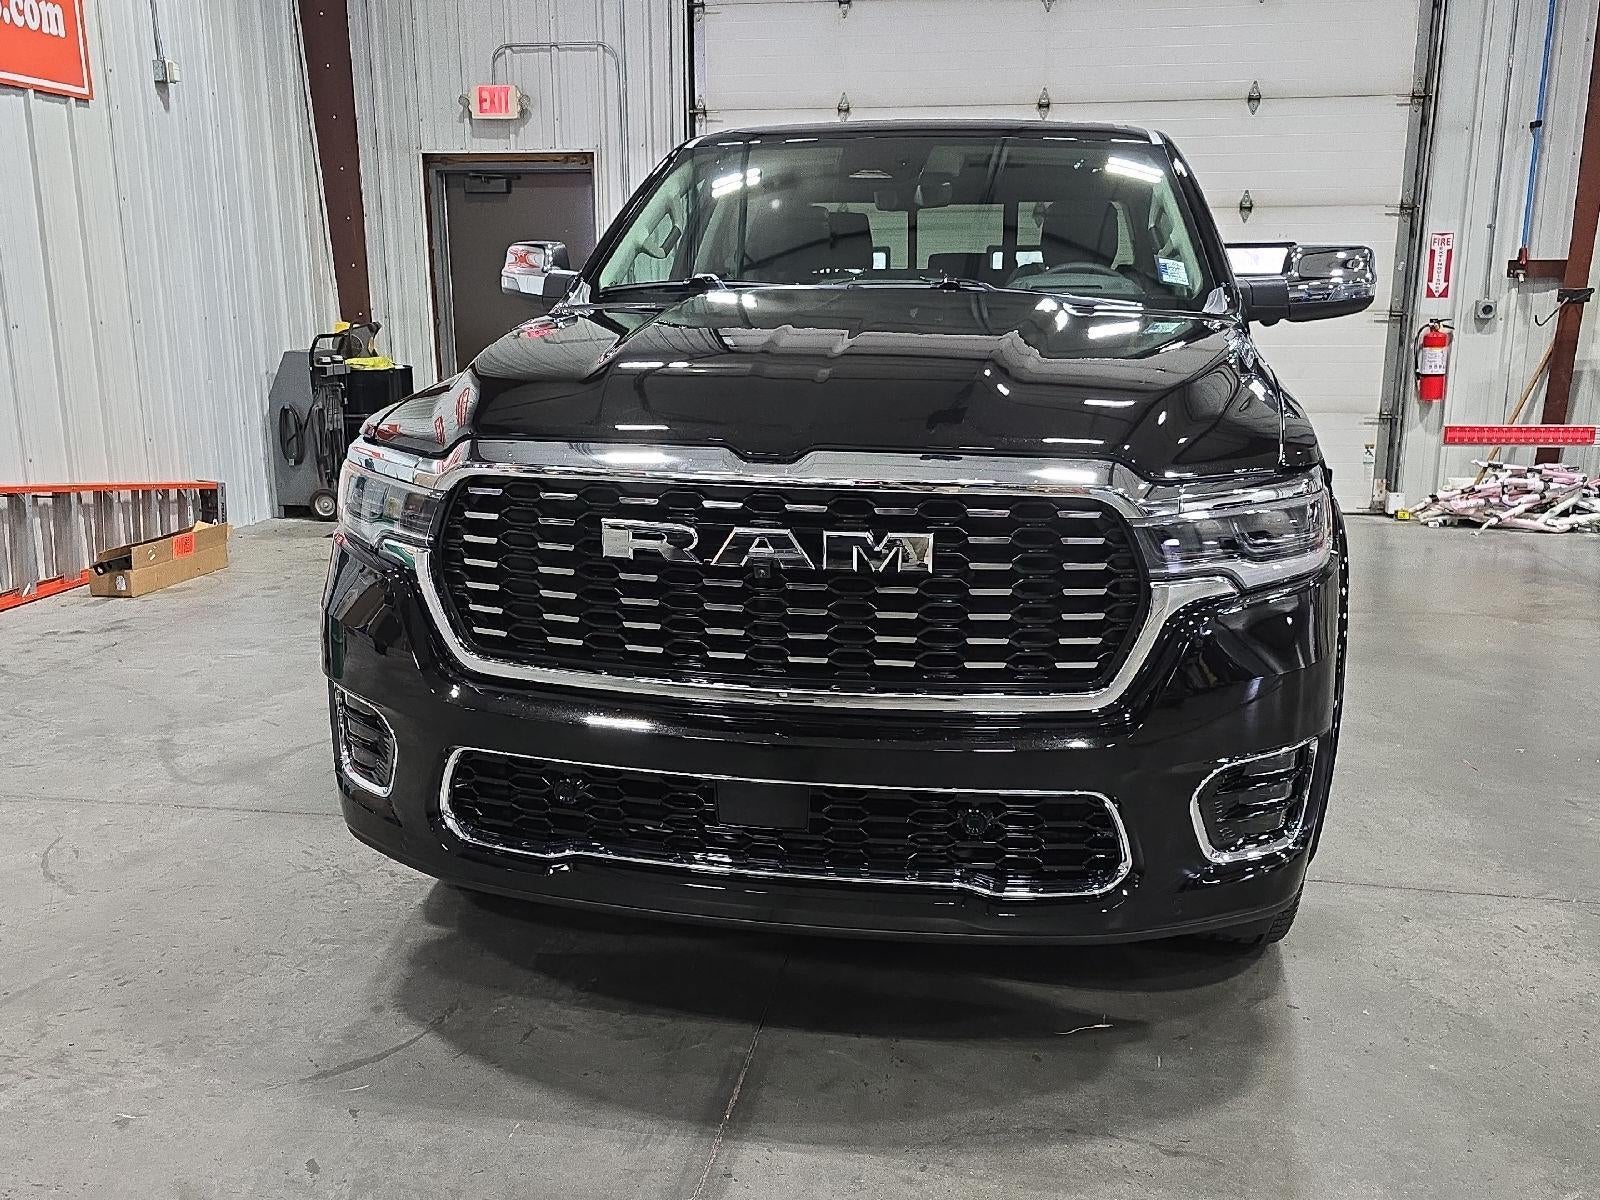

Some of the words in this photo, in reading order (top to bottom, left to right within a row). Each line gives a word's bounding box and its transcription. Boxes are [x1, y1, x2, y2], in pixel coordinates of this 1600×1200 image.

[0, 0, 66, 39] .com
[478, 87, 510, 113] EXIT
[1432, 237, 1451, 246] FIRE
[1435, 246, 1444, 293] EXTINGUISHER
[601, 518, 935, 573] RAM
